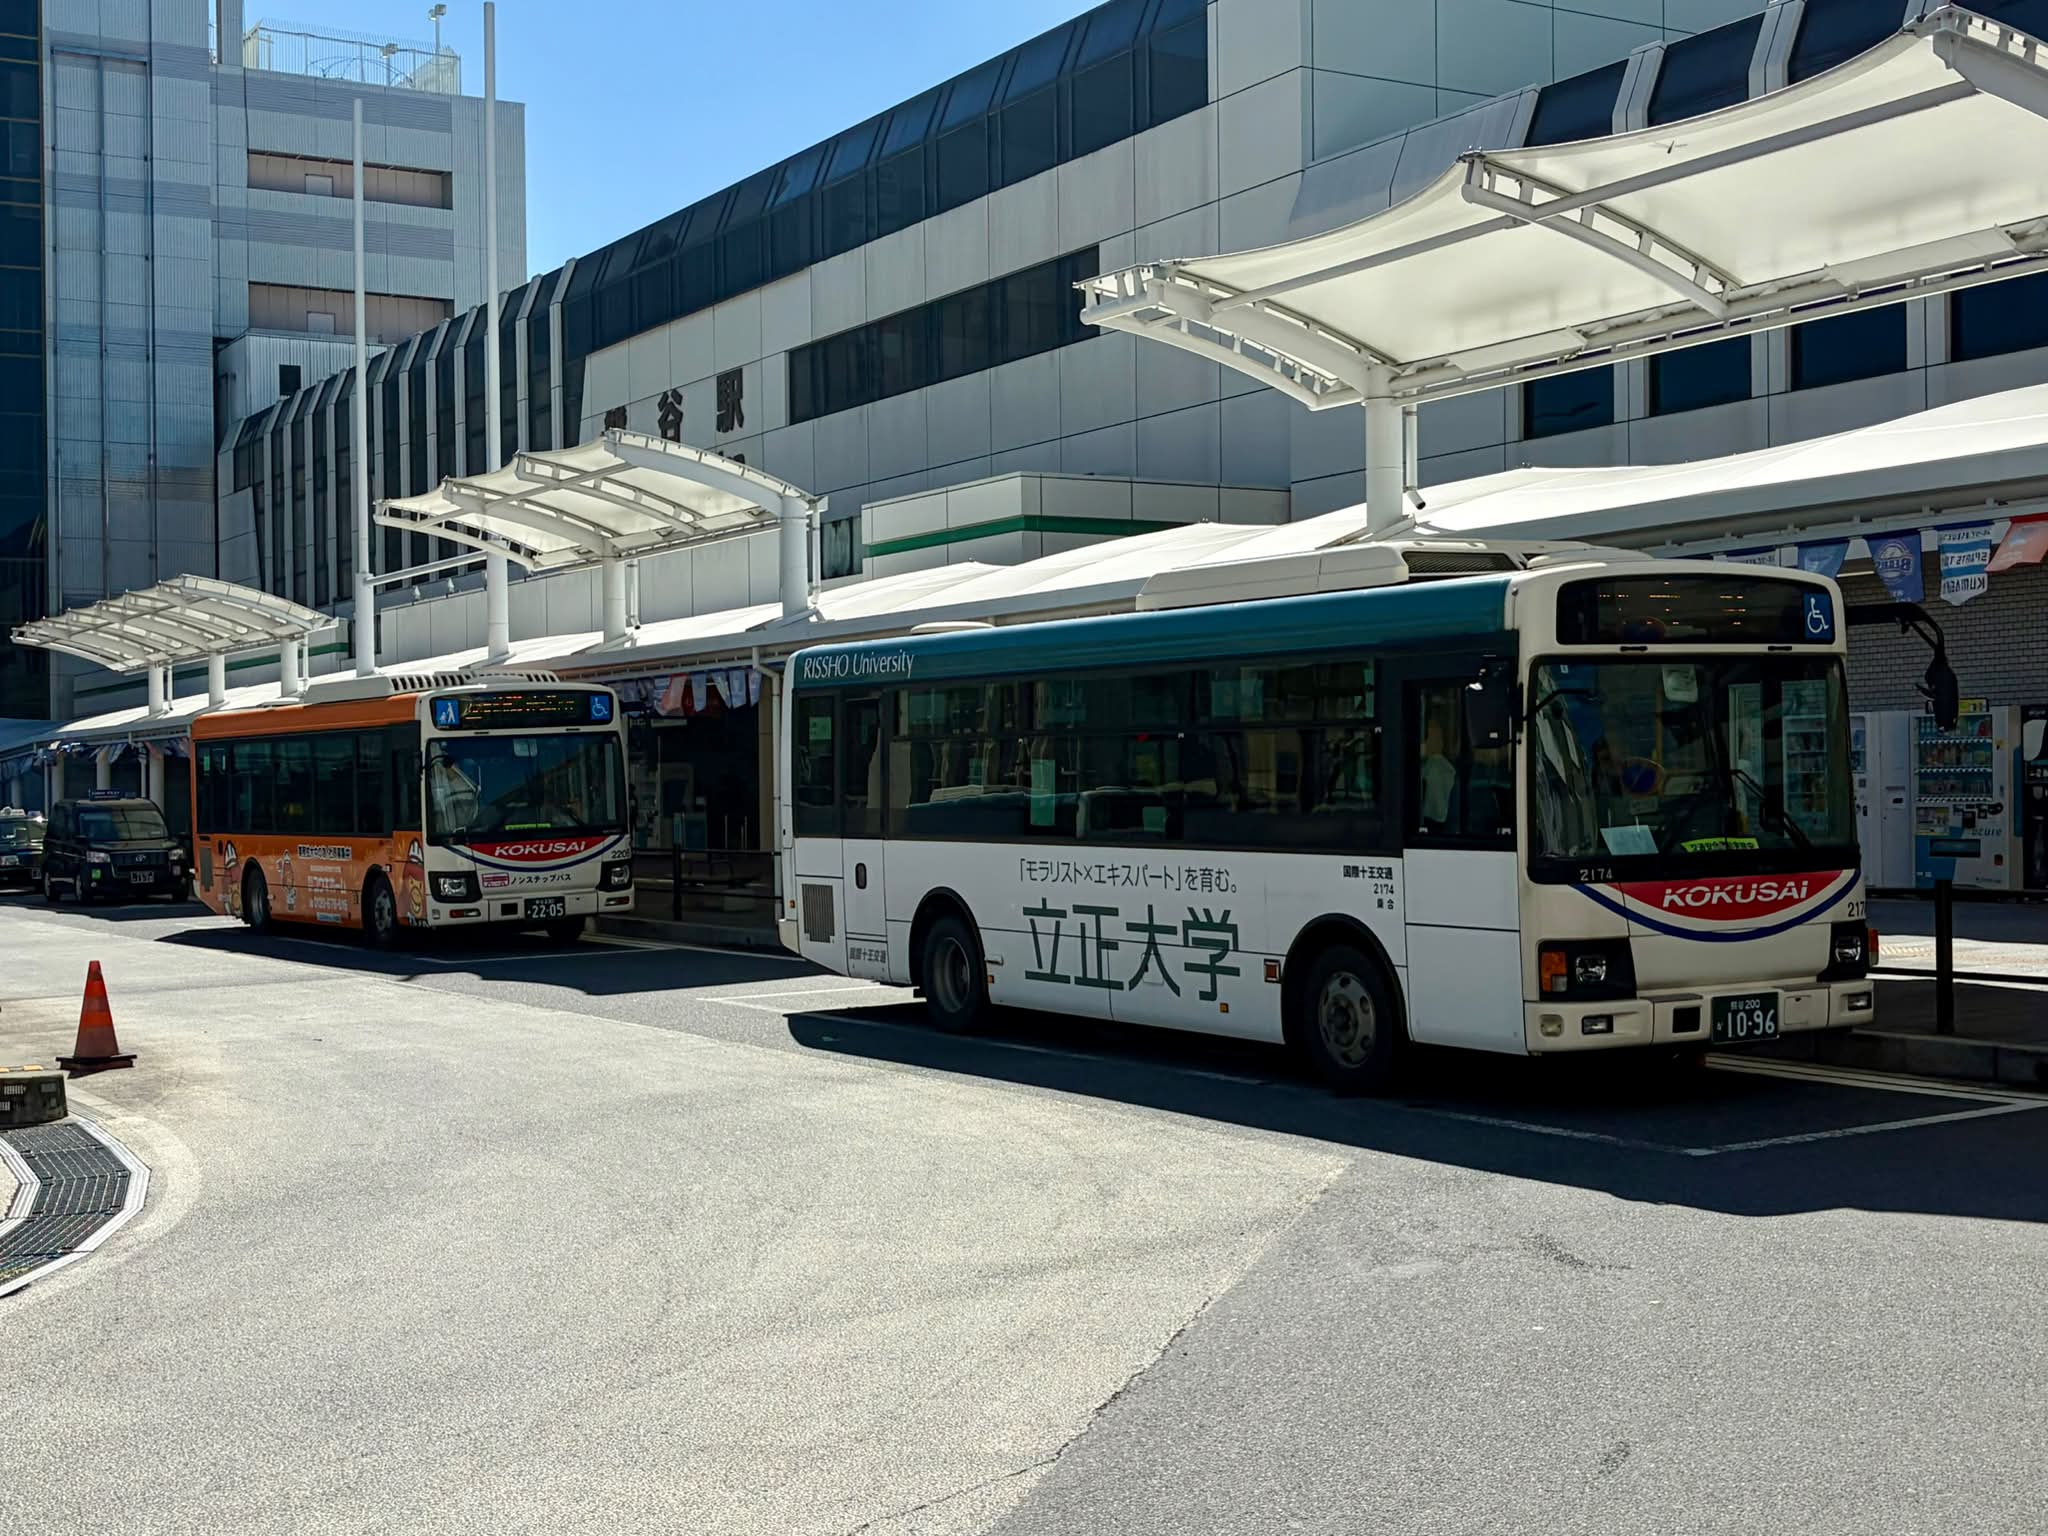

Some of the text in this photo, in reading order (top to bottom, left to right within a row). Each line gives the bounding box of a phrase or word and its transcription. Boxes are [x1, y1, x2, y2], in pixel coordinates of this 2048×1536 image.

[803, 649, 915, 679] RISSHO University
[494, 841, 586, 856] KOKUSAI
[511, 873, 572, 885] ノンステップバス
[1579, 868, 1613, 881] 2174
[1373, 883, 1394, 895] 2174
[1662, 880, 1809, 908] KOKUSAI
[1022, 897, 1241, 1001] 立正大学
[1745, 1000, 1760, 1009] 200
